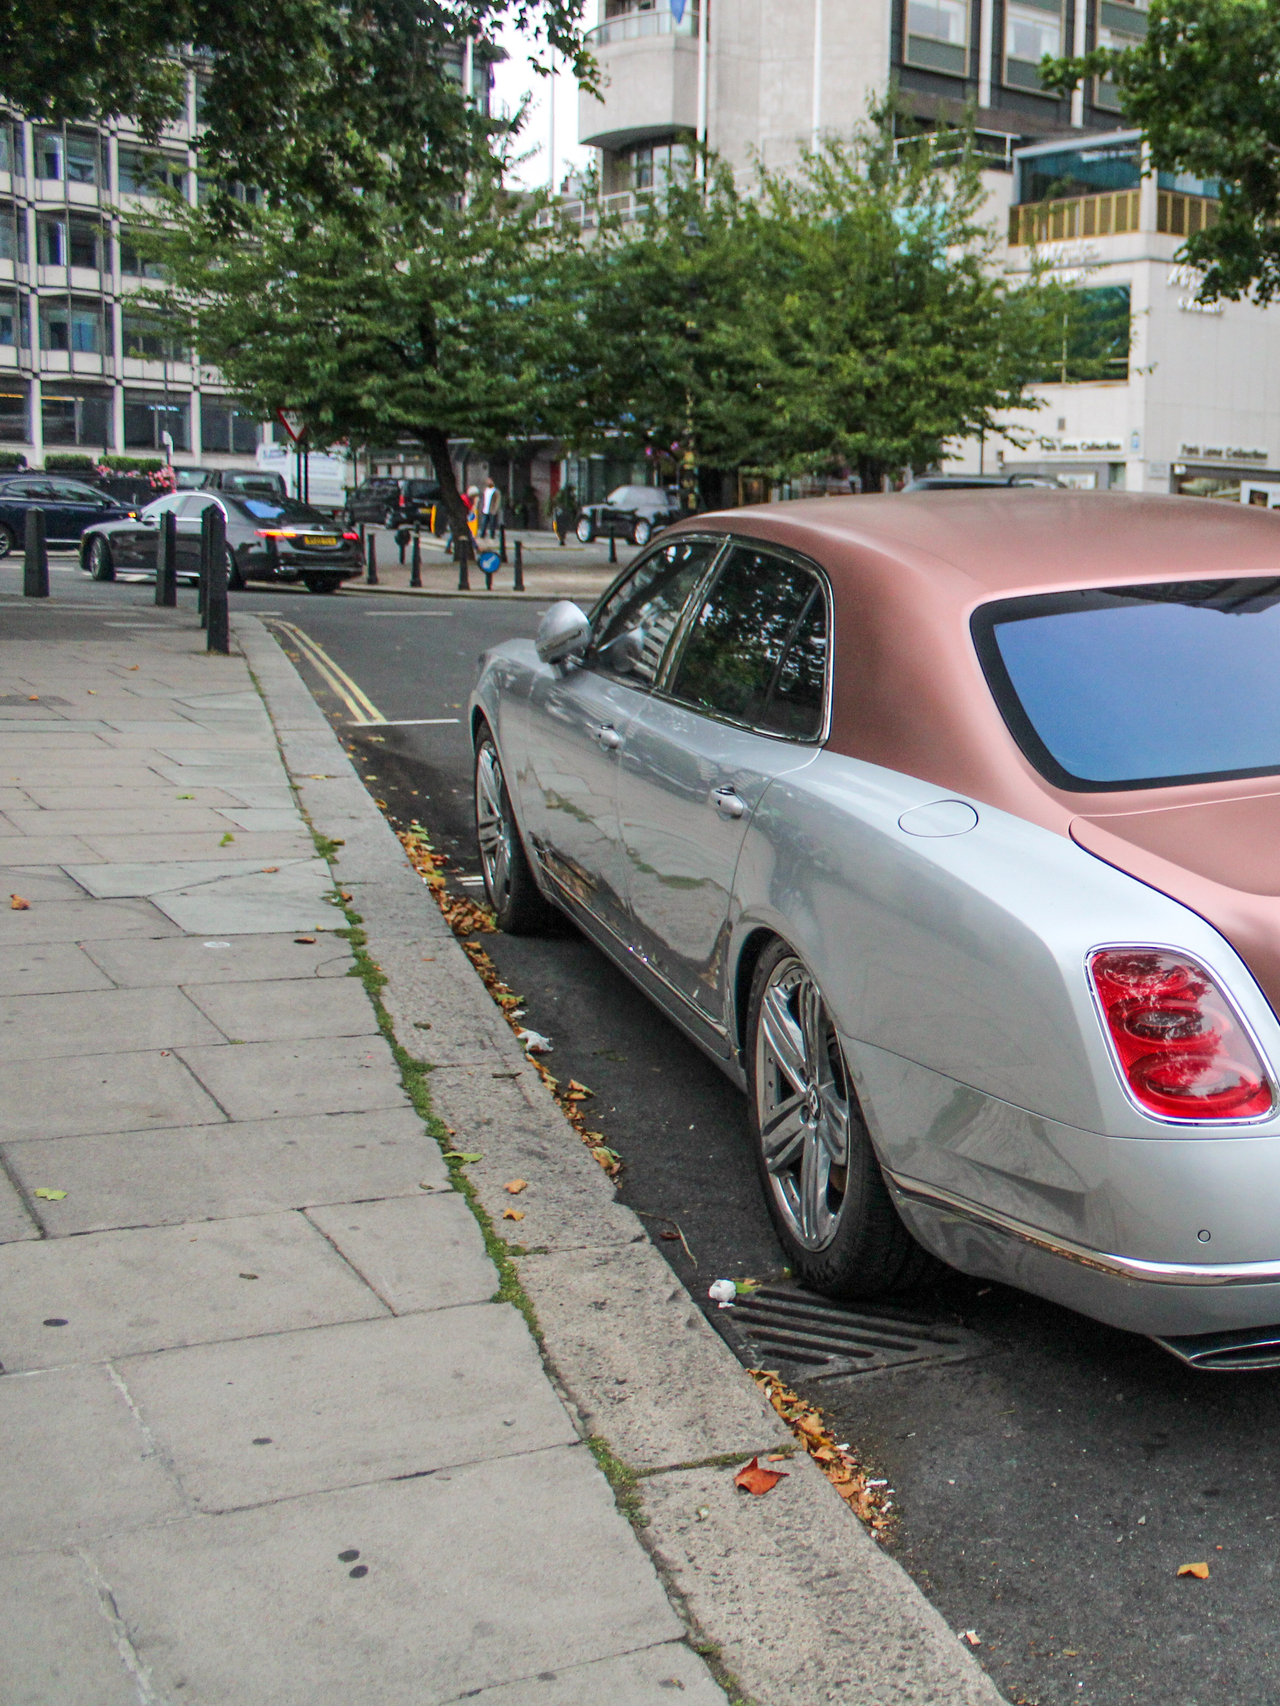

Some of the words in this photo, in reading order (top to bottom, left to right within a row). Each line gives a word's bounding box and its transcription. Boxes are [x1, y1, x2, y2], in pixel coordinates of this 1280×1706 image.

[1181, 444, 1199, 455] Park
[1203, 445, 1222, 457] Lane
[1225, 446, 1268, 459] Collection
